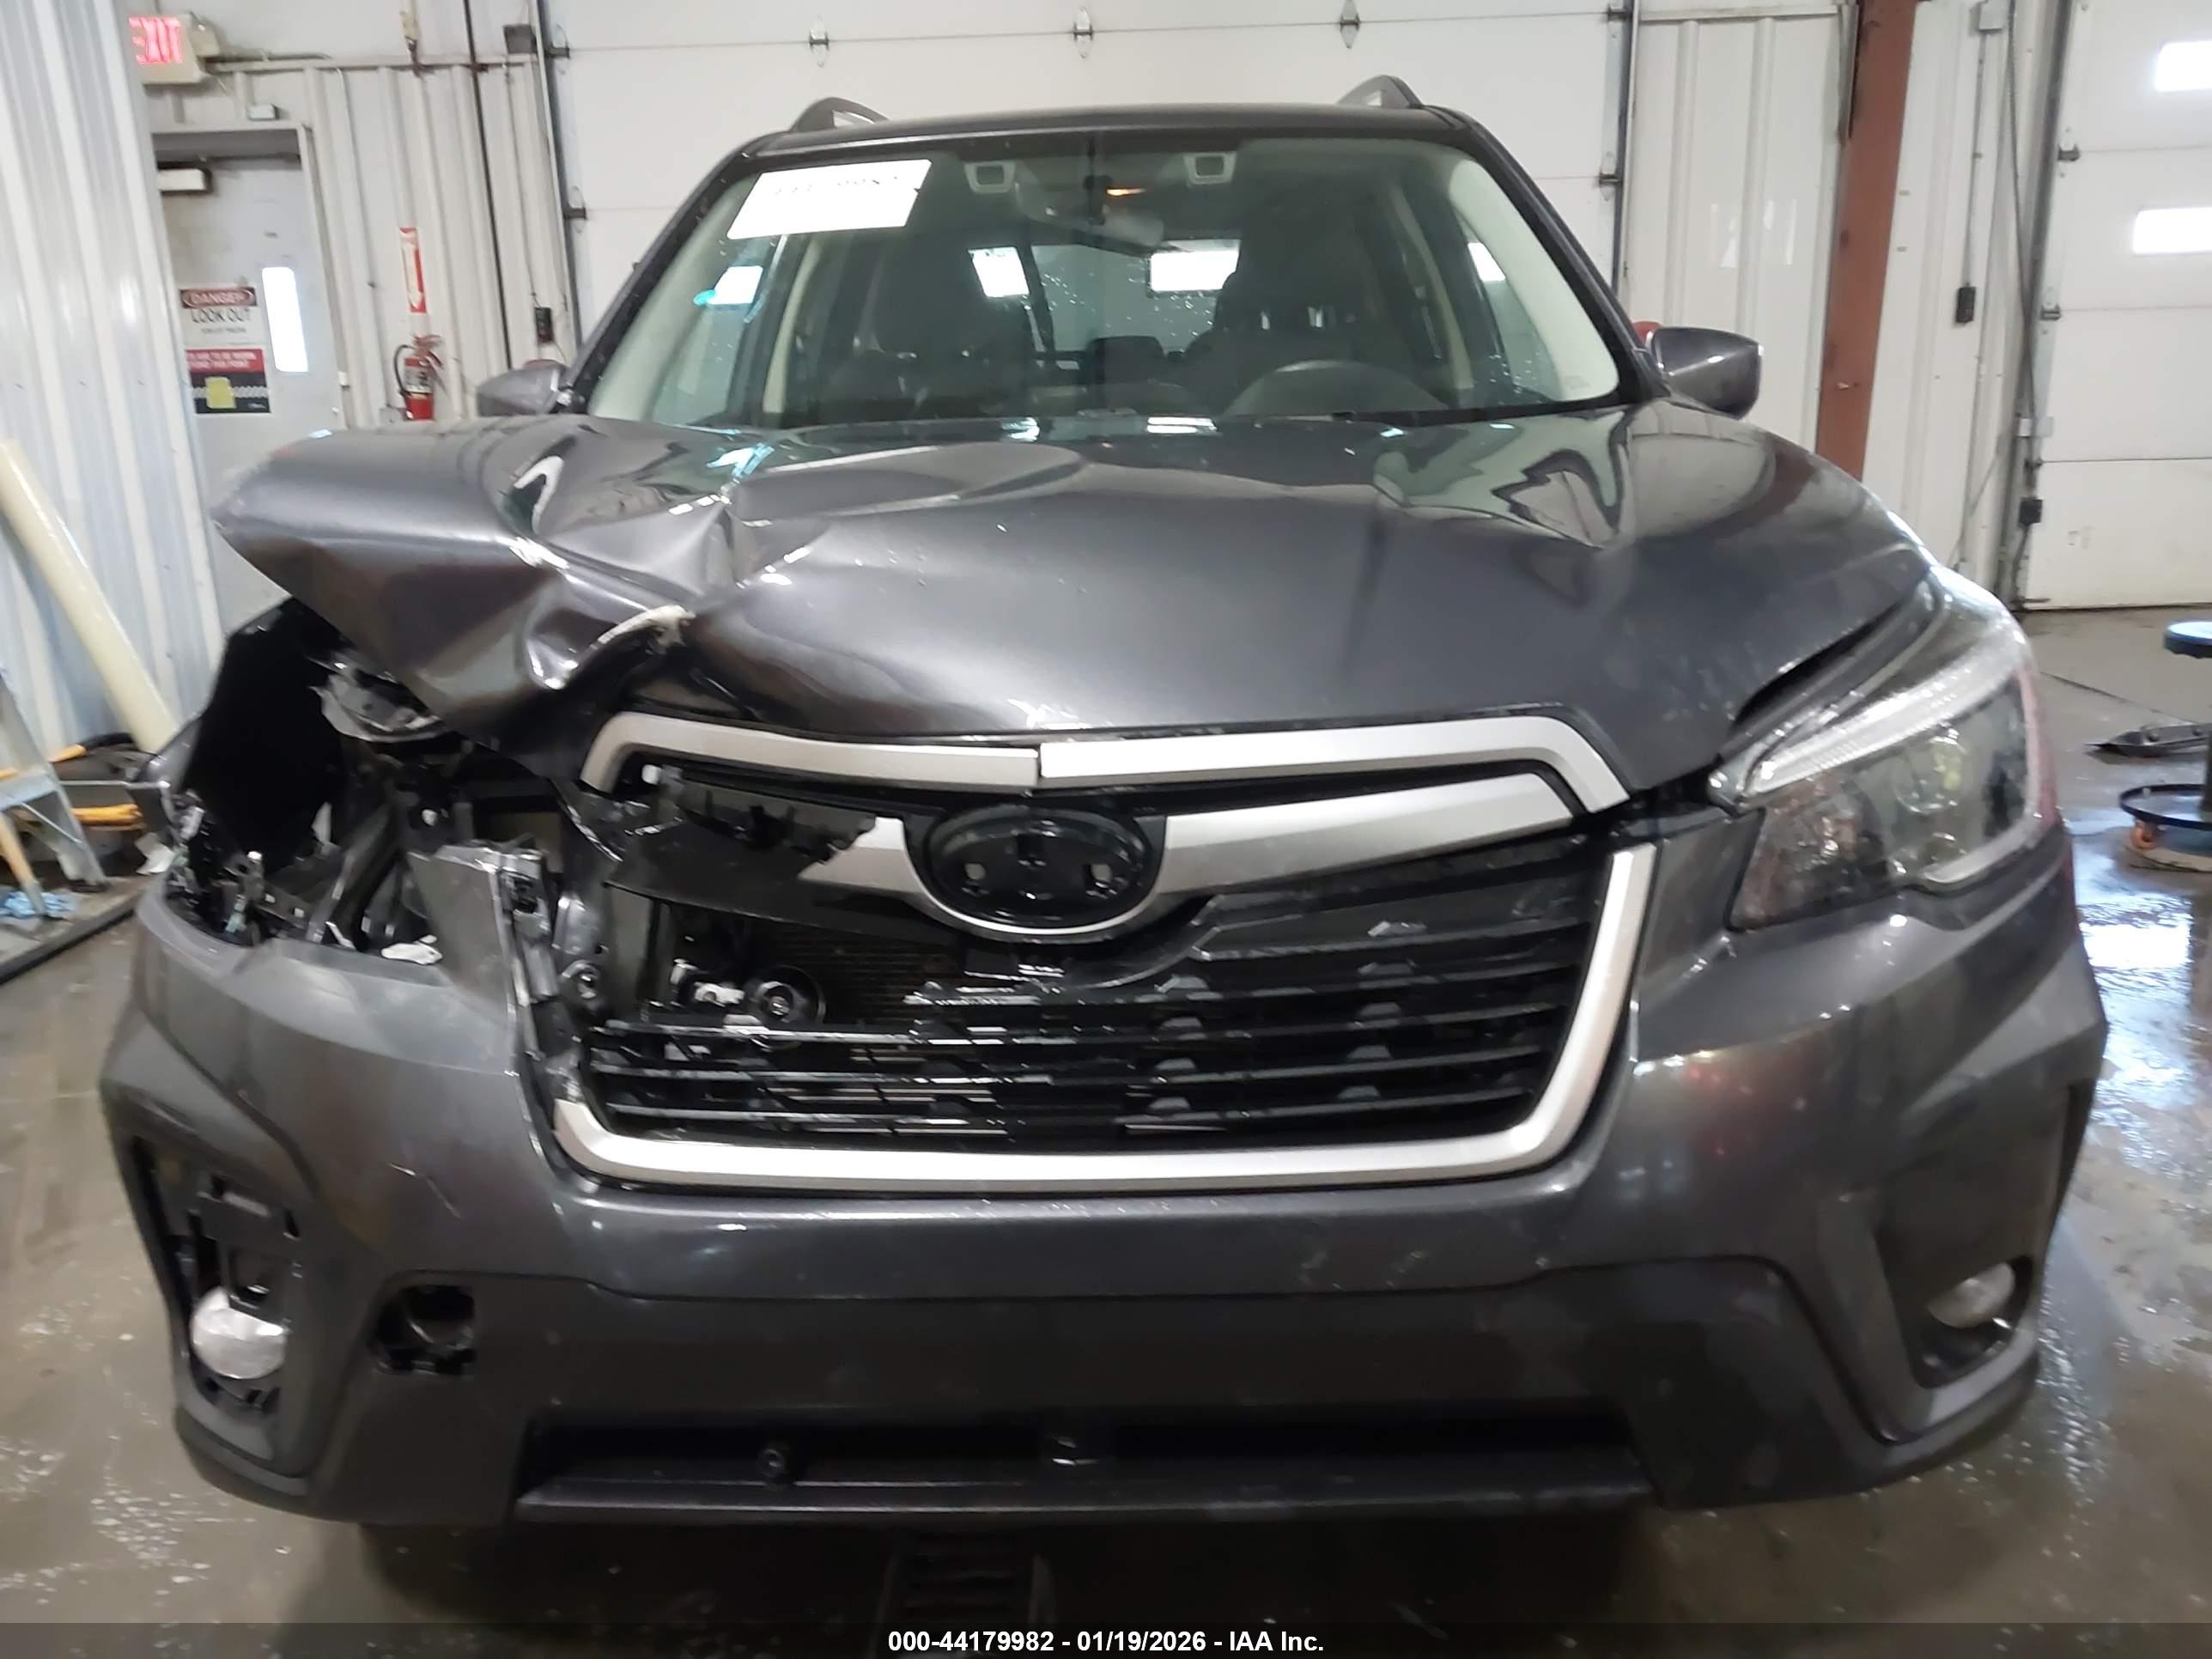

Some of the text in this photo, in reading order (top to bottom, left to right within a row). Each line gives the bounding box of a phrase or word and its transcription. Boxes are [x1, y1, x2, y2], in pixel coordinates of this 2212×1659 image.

[128, 16, 181, 64] EXIT
[191, 307, 251, 323] LOOK OUT
